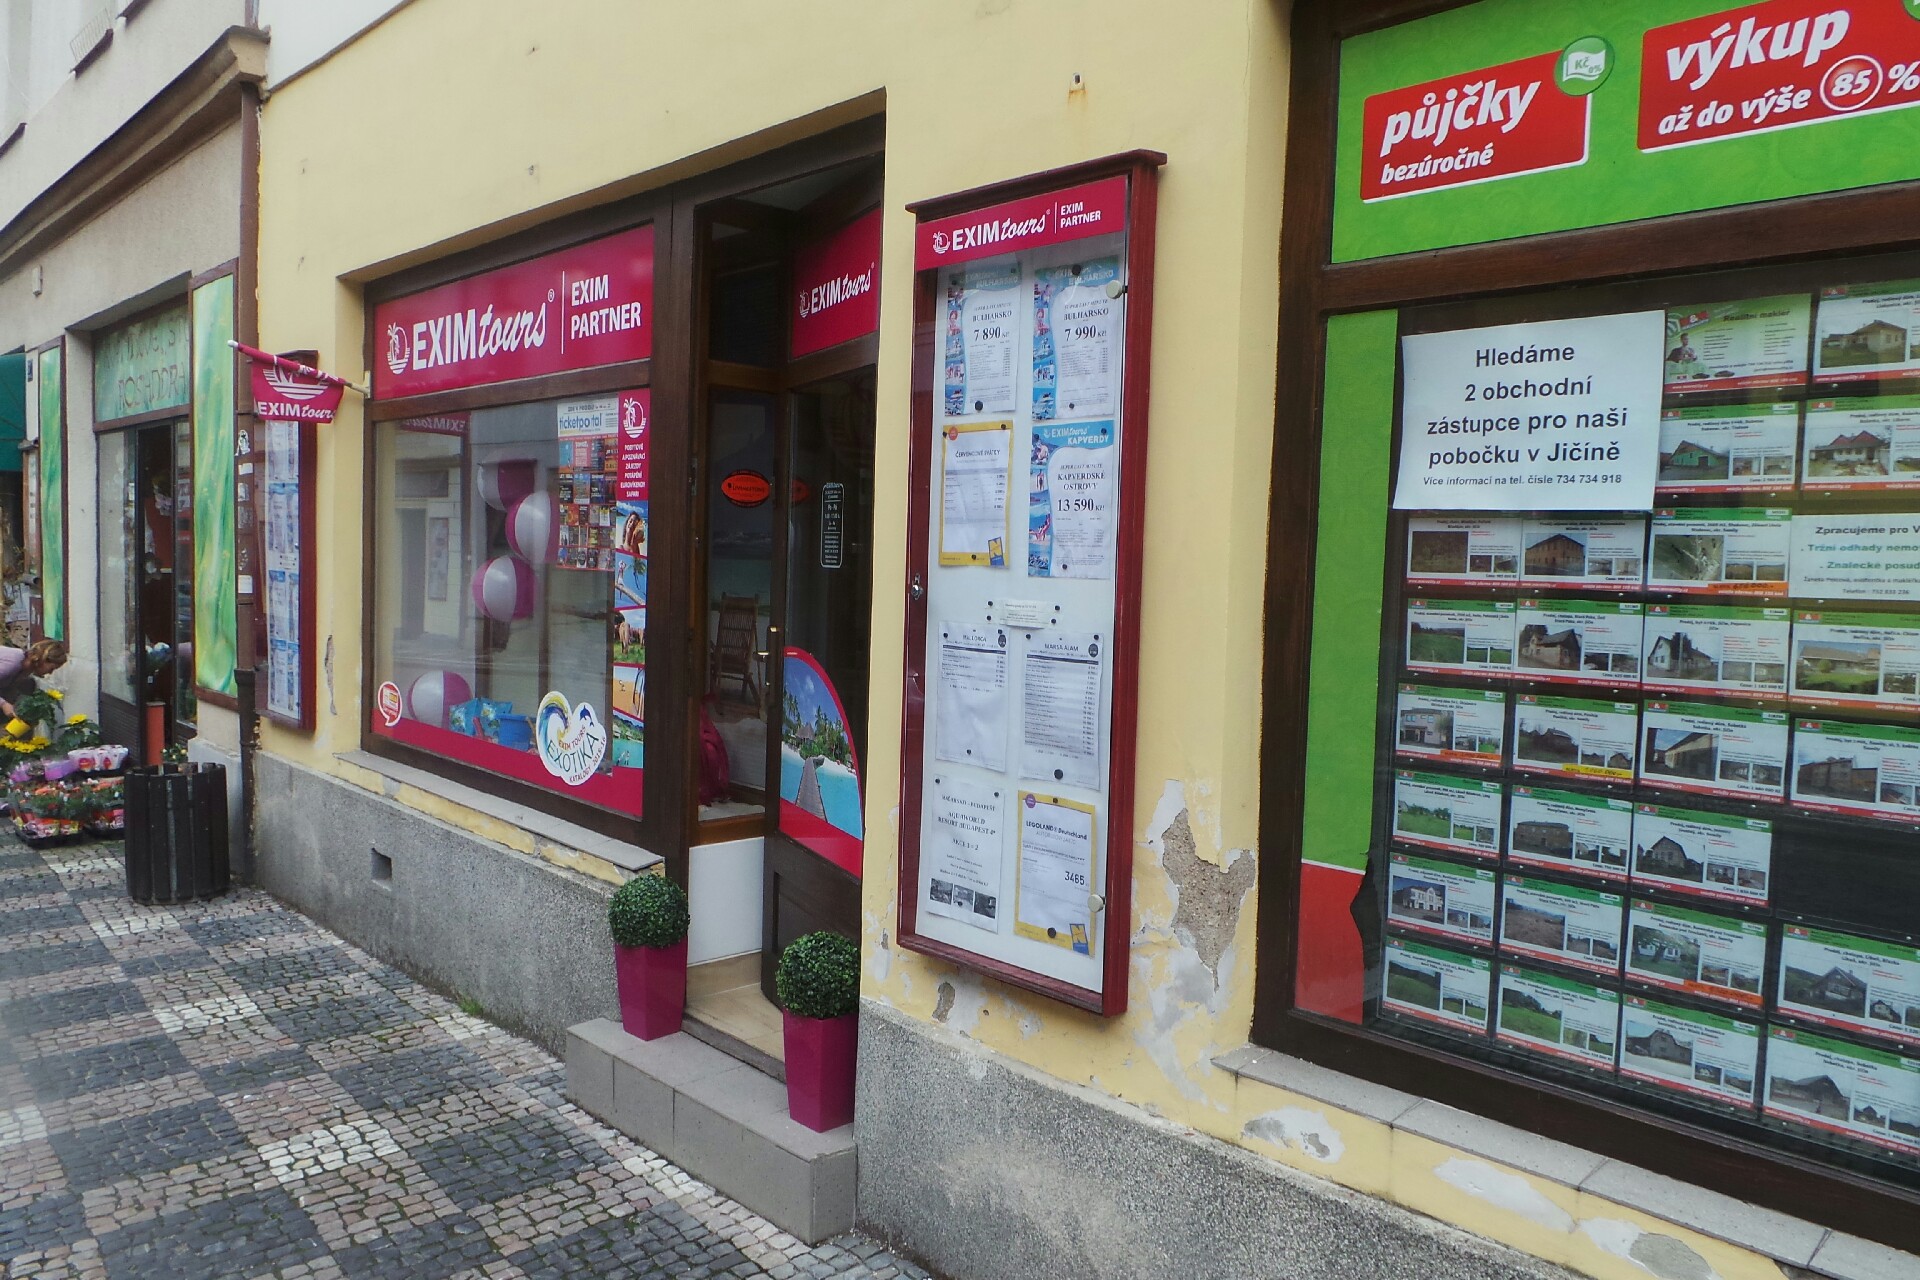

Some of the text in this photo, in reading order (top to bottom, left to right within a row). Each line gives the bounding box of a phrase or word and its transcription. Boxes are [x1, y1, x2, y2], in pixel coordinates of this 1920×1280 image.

[1665, 10, 1851, 90] výkup
[1575, 56, 1590, 70] Kč
[1658, 60, 1920, 136] až do výše 85 %
[1380, 77, 1542, 158] půjčky
[1380, 142, 1495, 185] bezúročné
[1060, 201, 1084, 216] EXIM
[1060, 210, 1101, 229] PARTNER
[952, 212, 1046, 252] EXIMtours
[571, 274, 610, 307] EXIM
[811, 271, 871, 313] EXIMtours
[571, 302, 642, 340] PARTNER
[972, 310, 1012, 323] BULHARSKO
[1063, 308, 1109, 321] BULHARSKO
[412, 302, 547, 371] EXIMtours
[983, 326, 1001, 341] 890
[1075, 325, 1097, 340] 990
[1476, 345, 1575, 367] Hledáme
[1464, 376, 1593, 402] 2 obchodní
[1427, 408, 1628, 438] zástupce pro naši
[1067, 435, 1109, 445] KAPVERDY
[1428, 441, 1621, 469] pobočku v Jičíně
[1057, 470, 1105, 481] KAPVERDSKÉ
[1447, 475, 1492, 486] informací
[1495, 477, 1507, 485] na
[1509, 475, 1525, 485] tel.
[1557, 474, 1576, 484] 734
[1579, 474, 1598, 484] 734
[1601, 474, 1622, 484] 918
[1063, 482, 1098, 491] OSTROVY
[1058, 498, 1070, 511] 13
[1074, 498, 1094, 511] 590
[1815, 525, 1886, 536] Zpracujeme
[1889, 527, 1909, 536] pro
[1839, 543, 1883, 553] odhady
[547, 732, 599, 773] EXOTIKA
[1064, 870, 1085, 886] 3465
